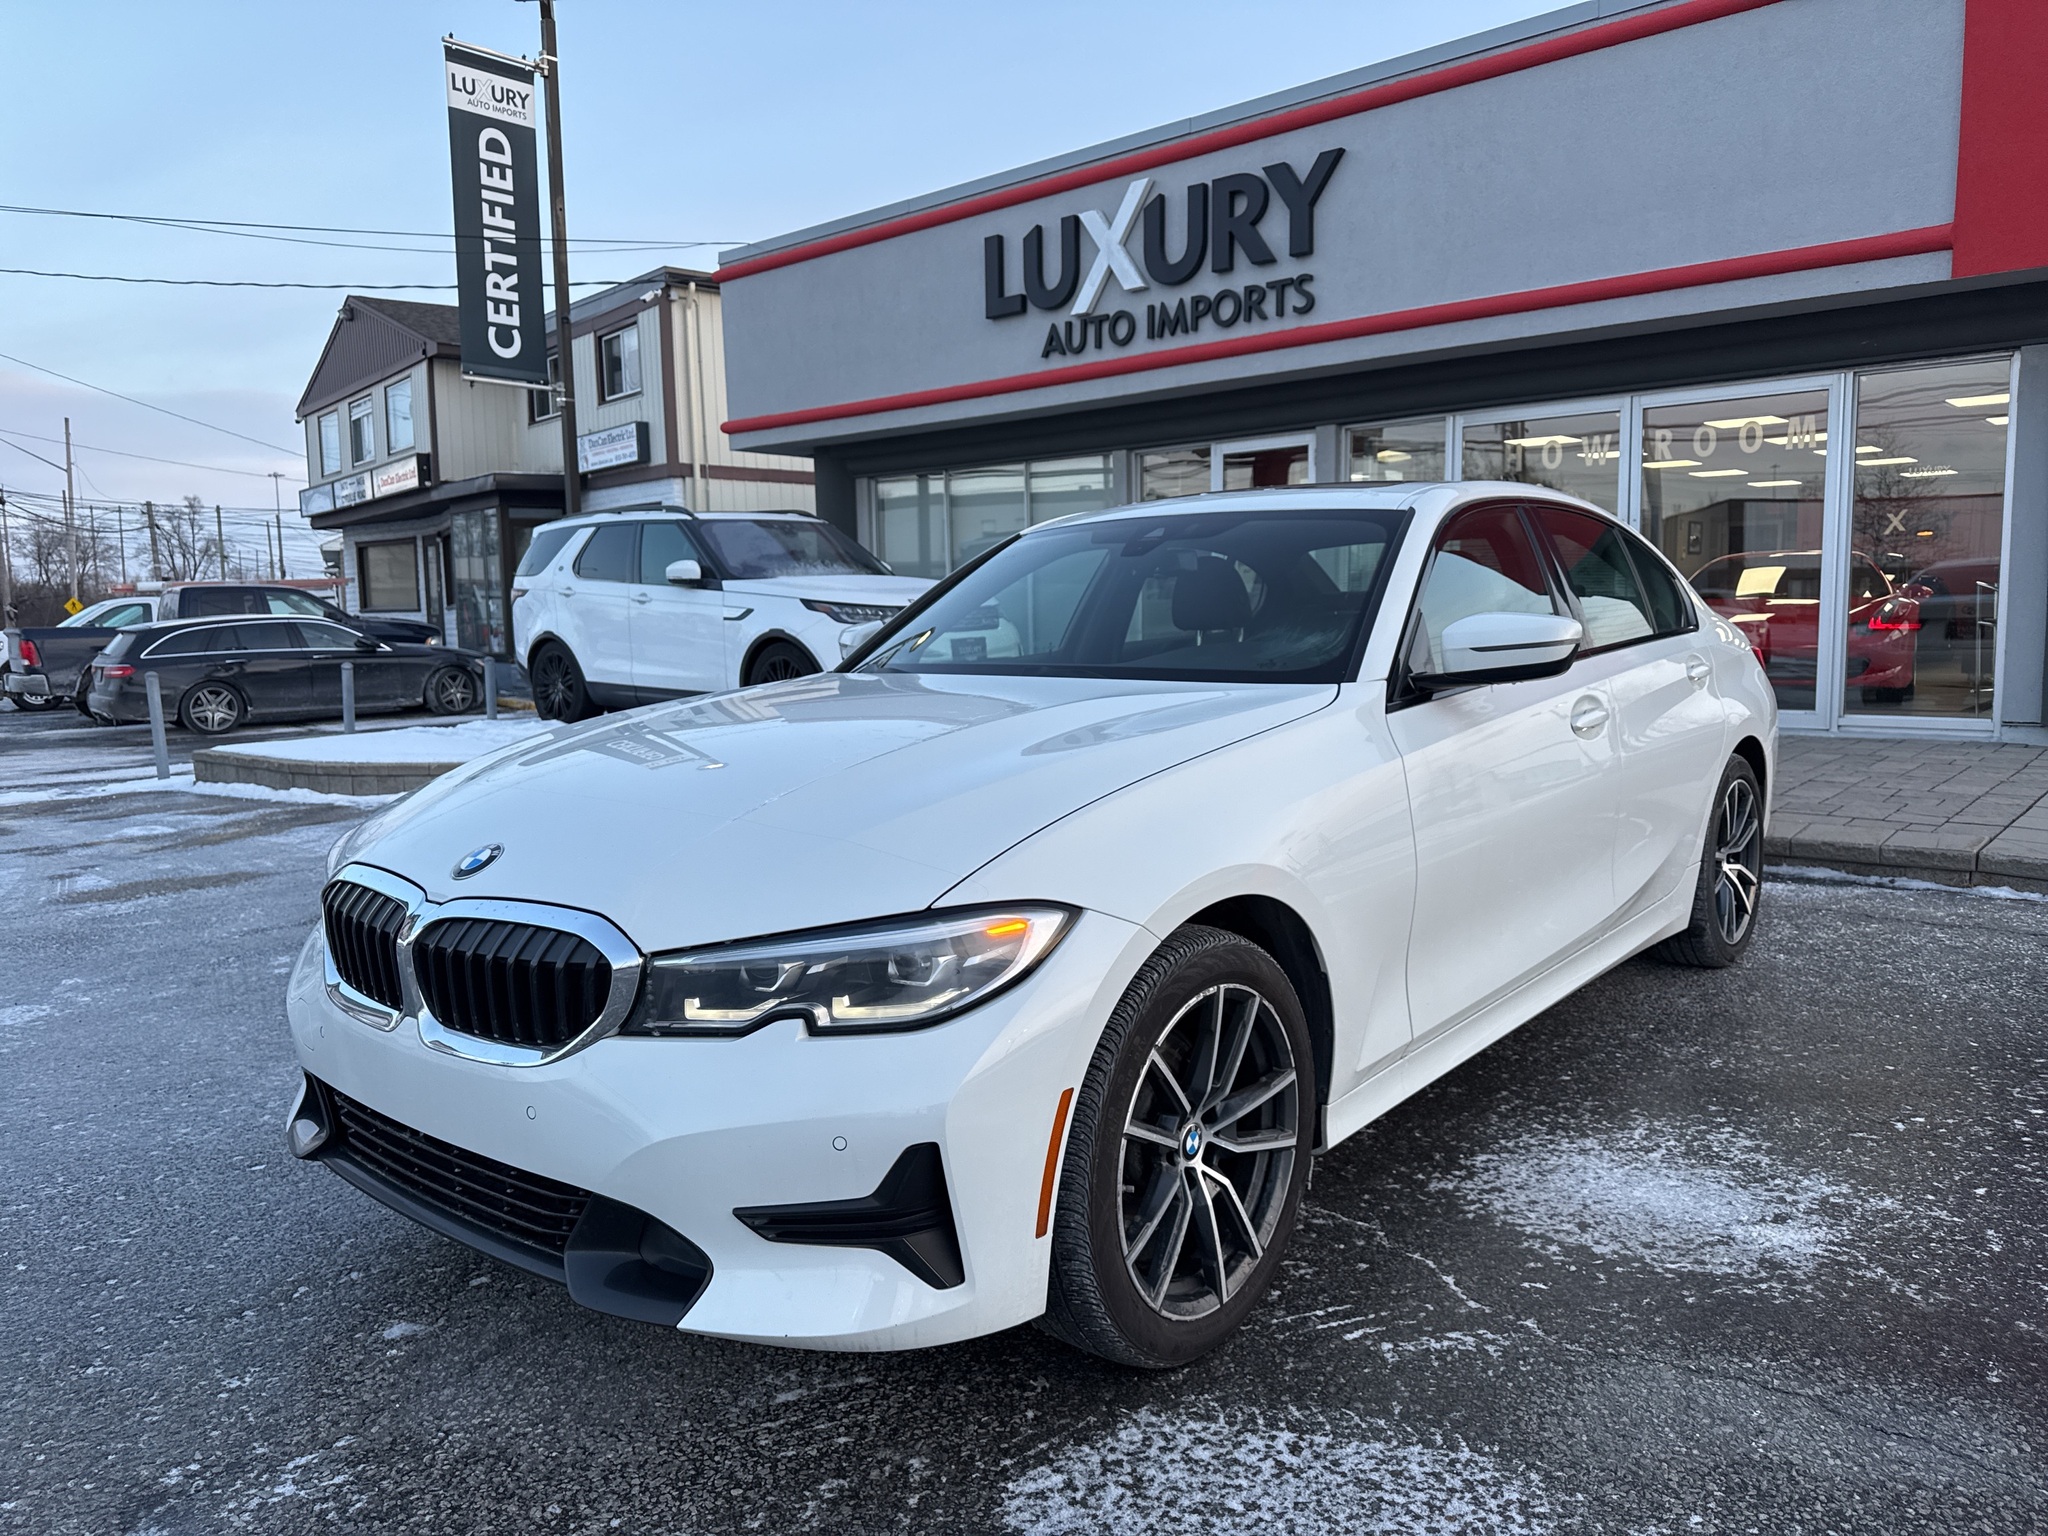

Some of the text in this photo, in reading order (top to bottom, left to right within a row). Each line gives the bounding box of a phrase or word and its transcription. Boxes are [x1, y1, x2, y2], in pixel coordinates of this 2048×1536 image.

[451, 72, 530, 110] LUXURY
[467, 98, 527, 120] AUTO IMPORTS
[478, 127, 522, 359] CERTIFIED
[984, 147, 1346, 319] LUXURY
[1041, 273, 1316, 358] AUTO IMPORTS
